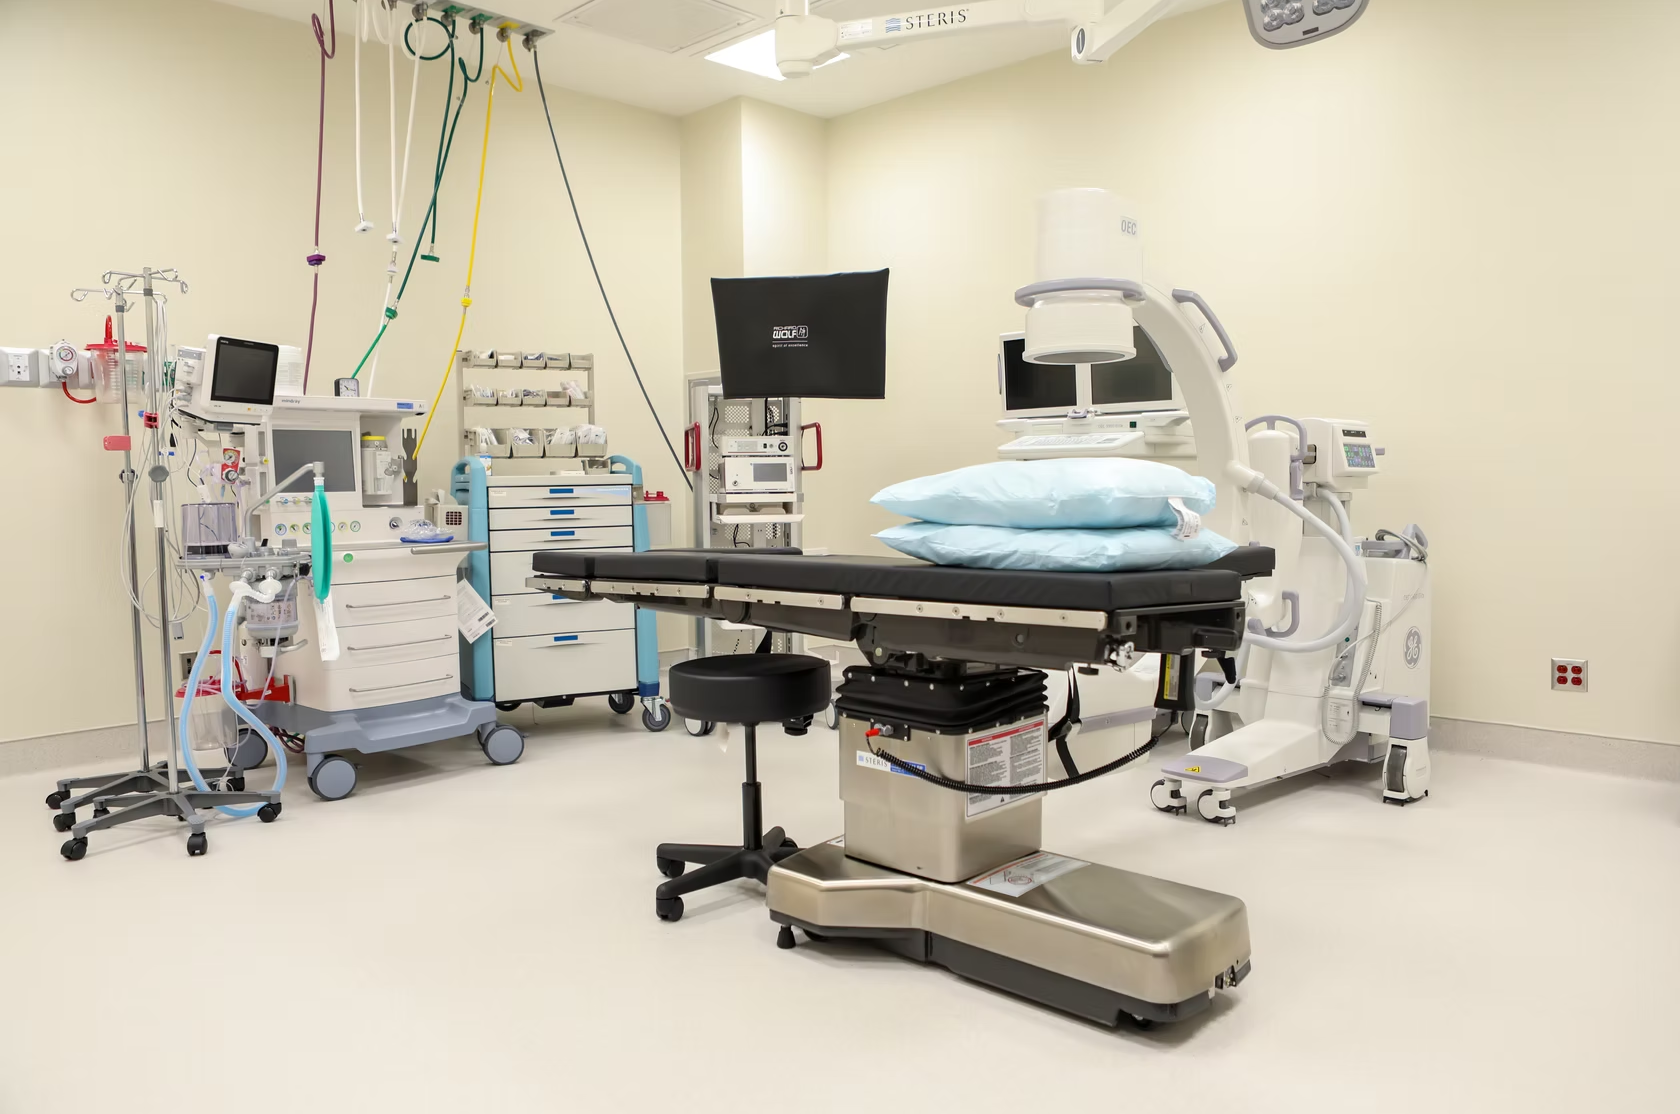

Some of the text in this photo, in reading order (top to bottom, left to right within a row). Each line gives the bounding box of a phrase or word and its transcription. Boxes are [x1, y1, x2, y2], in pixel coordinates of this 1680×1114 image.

[904, 9, 967, 30] STERIS
[1121, 219, 1137, 235] OEC
[773, 330, 797, 339] WOLF
[865, 756, 888, 768] STERIS
